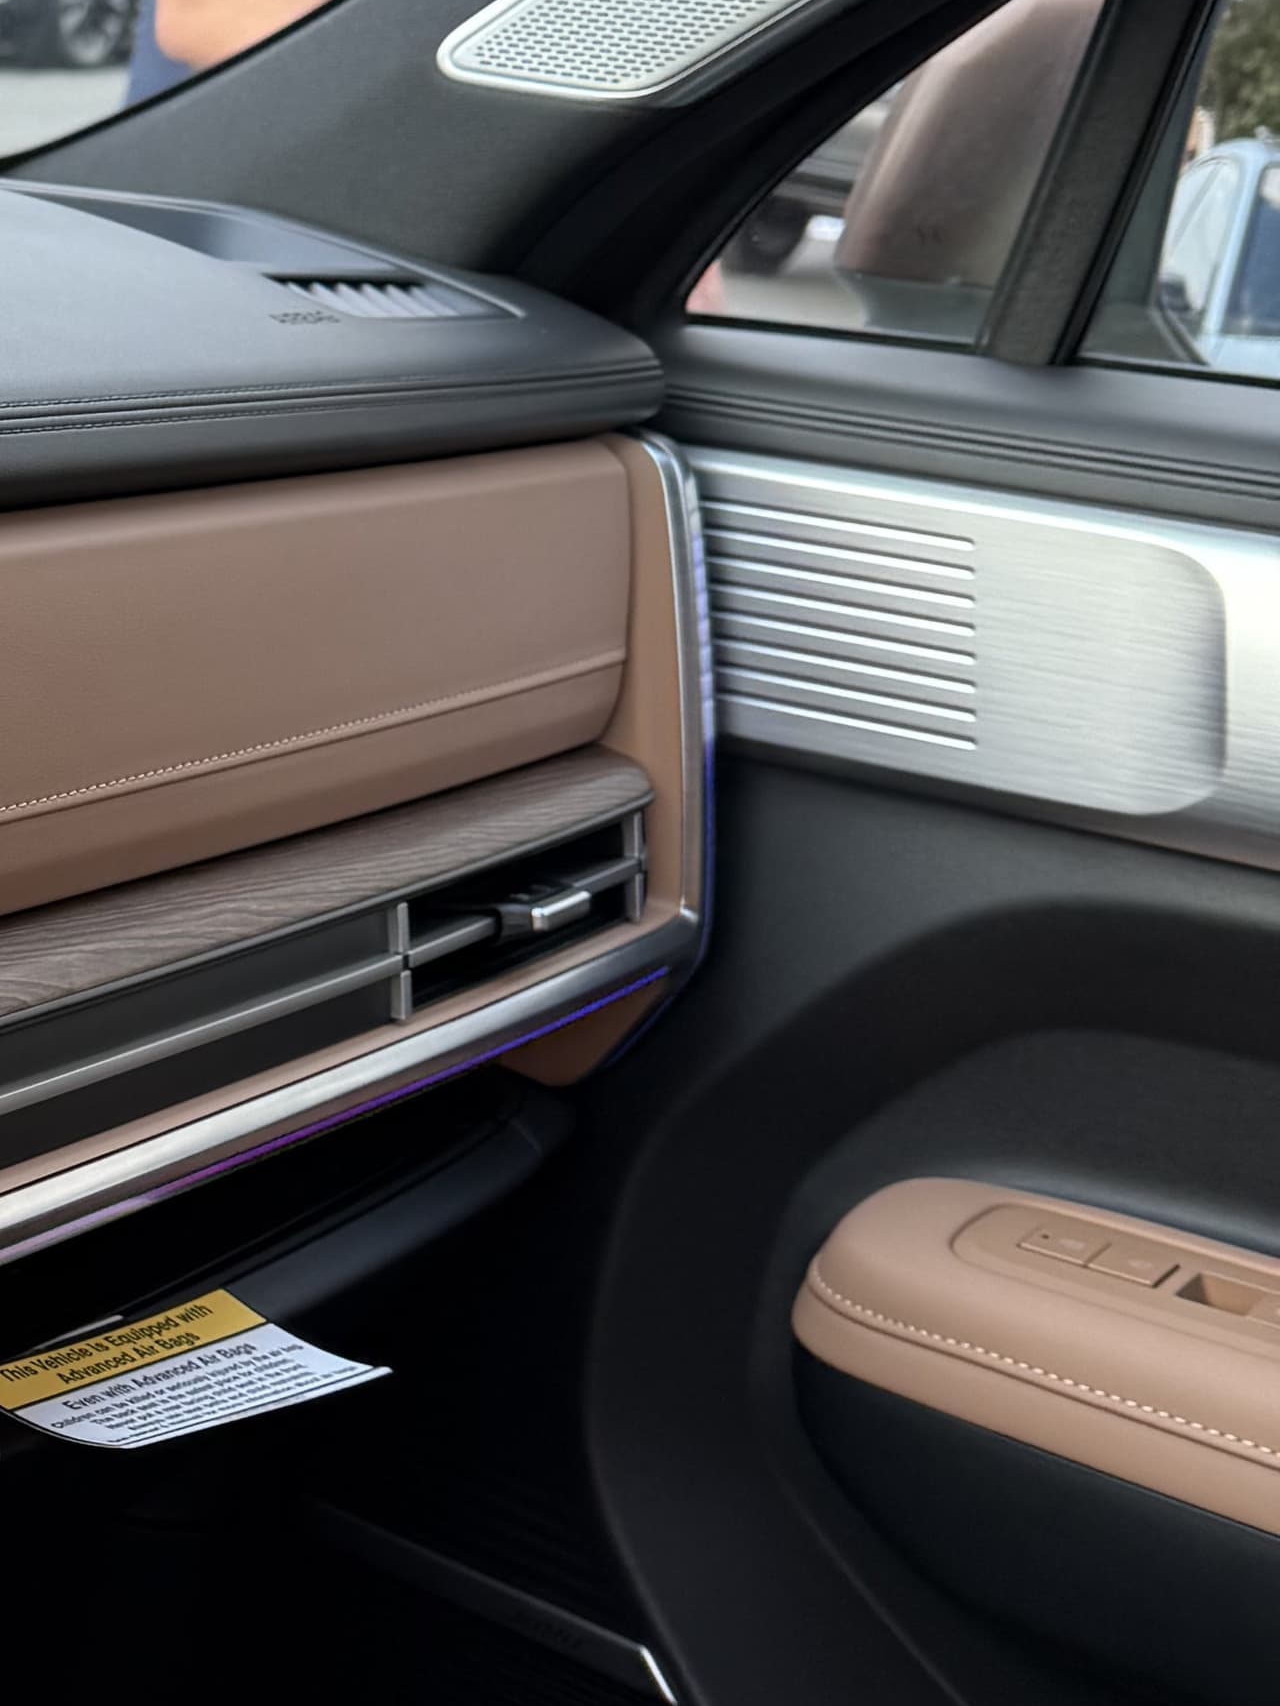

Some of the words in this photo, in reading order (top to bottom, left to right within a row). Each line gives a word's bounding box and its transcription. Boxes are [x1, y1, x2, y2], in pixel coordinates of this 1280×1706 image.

[32, 1346, 93, 1373] Vehicle
[92, 1340, 110, 1354] is
[103, 1315, 180, 1347] Equipped
[176, 1303, 213, 1325] with
[56, 1351, 137, 1385] Advanced
[133, 1343, 156, 1360] Air
[155, 1329, 201, 1351] Bags
[62, 1391, 108, 1411] Even
[101, 1382, 137, 1399] with
[131, 1357, 202, 1387] Advanced
[197, 1353, 222, 1368] Air
[216, 1342, 259, 1360] Bags
